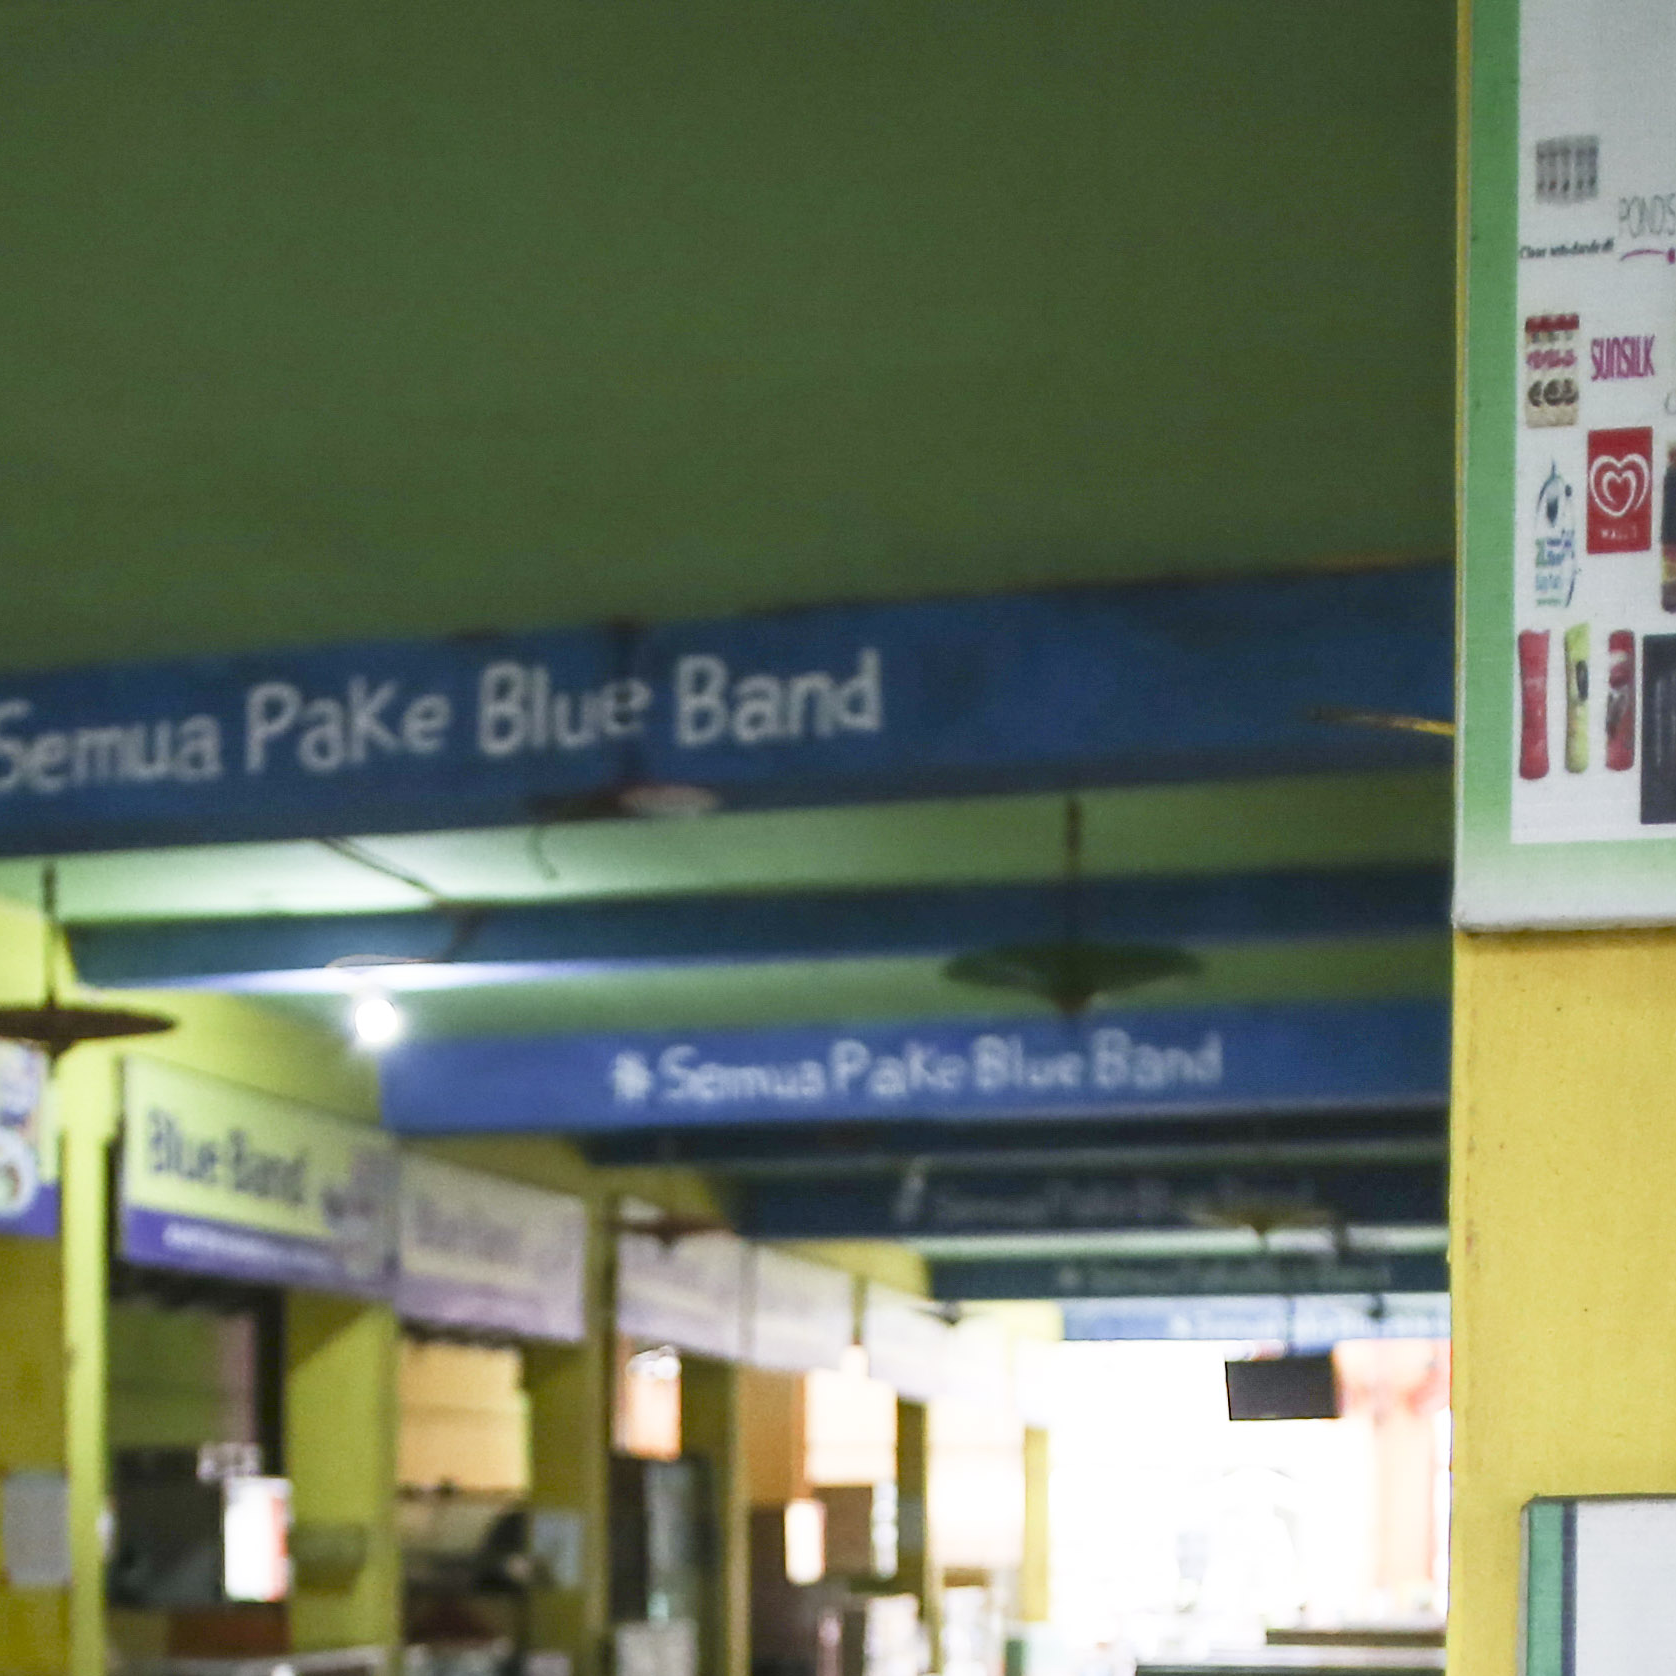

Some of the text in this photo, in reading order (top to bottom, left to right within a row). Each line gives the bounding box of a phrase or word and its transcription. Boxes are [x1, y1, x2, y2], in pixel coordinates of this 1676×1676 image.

[476, 661, 652, 757] Blue
[673, 649, 883, 748] Band
[659, 1044, 826, 1105] Semua
[971, 1034, 1084, 1092] Blue
[1091, 1027, 1223, 1089] Band
[146, 1106, 310, 1206] Blue Band
